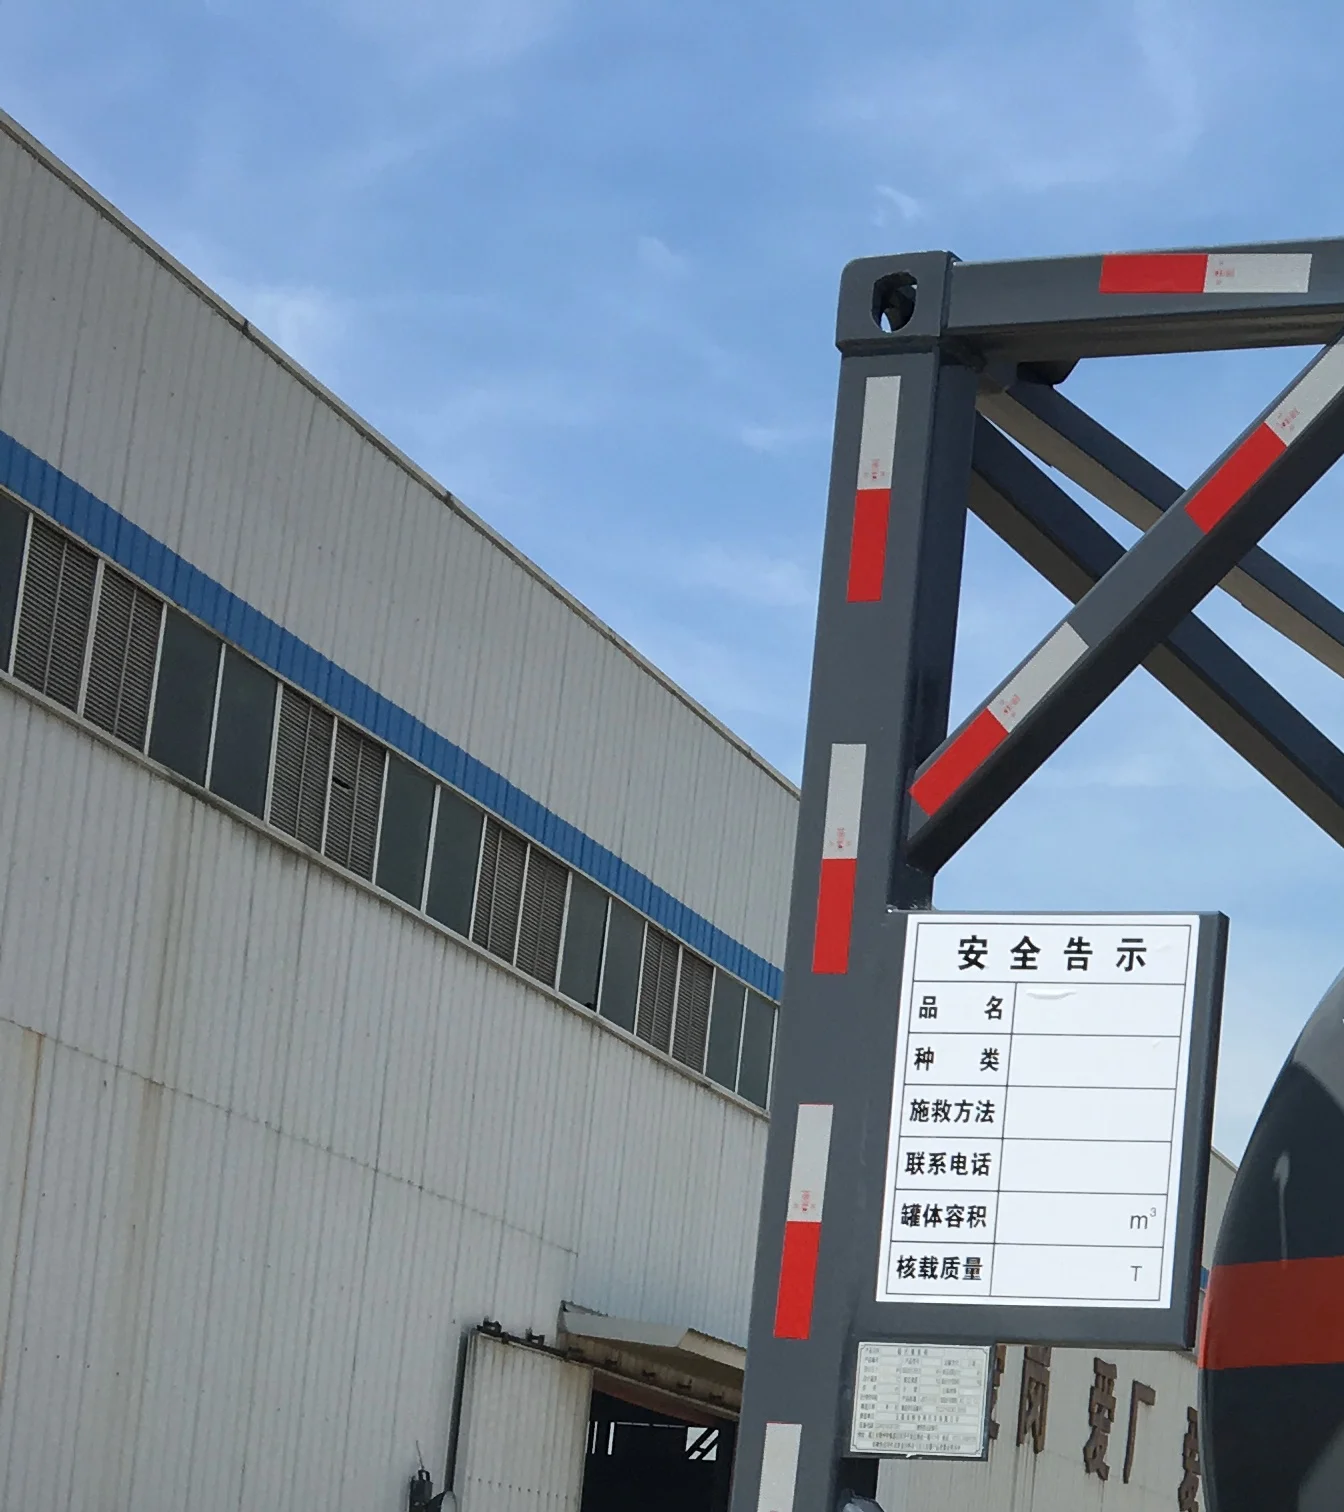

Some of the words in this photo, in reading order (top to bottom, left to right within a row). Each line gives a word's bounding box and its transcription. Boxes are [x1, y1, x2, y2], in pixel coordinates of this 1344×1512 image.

[957, 934, 1148, 972] 安全告示
[917, 995, 1004, 1021] 品名
[913, 1046, 1001, 1072] 种类
[909, 1099, 995, 1124] 施救方法
[904, 1151, 992, 1177] 联系电话
[900, 1203, 988, 1229] 罐体容积
[896, 1255, 984, 1282] 核载质量
[1129, 1265, 1143, 1282] T
